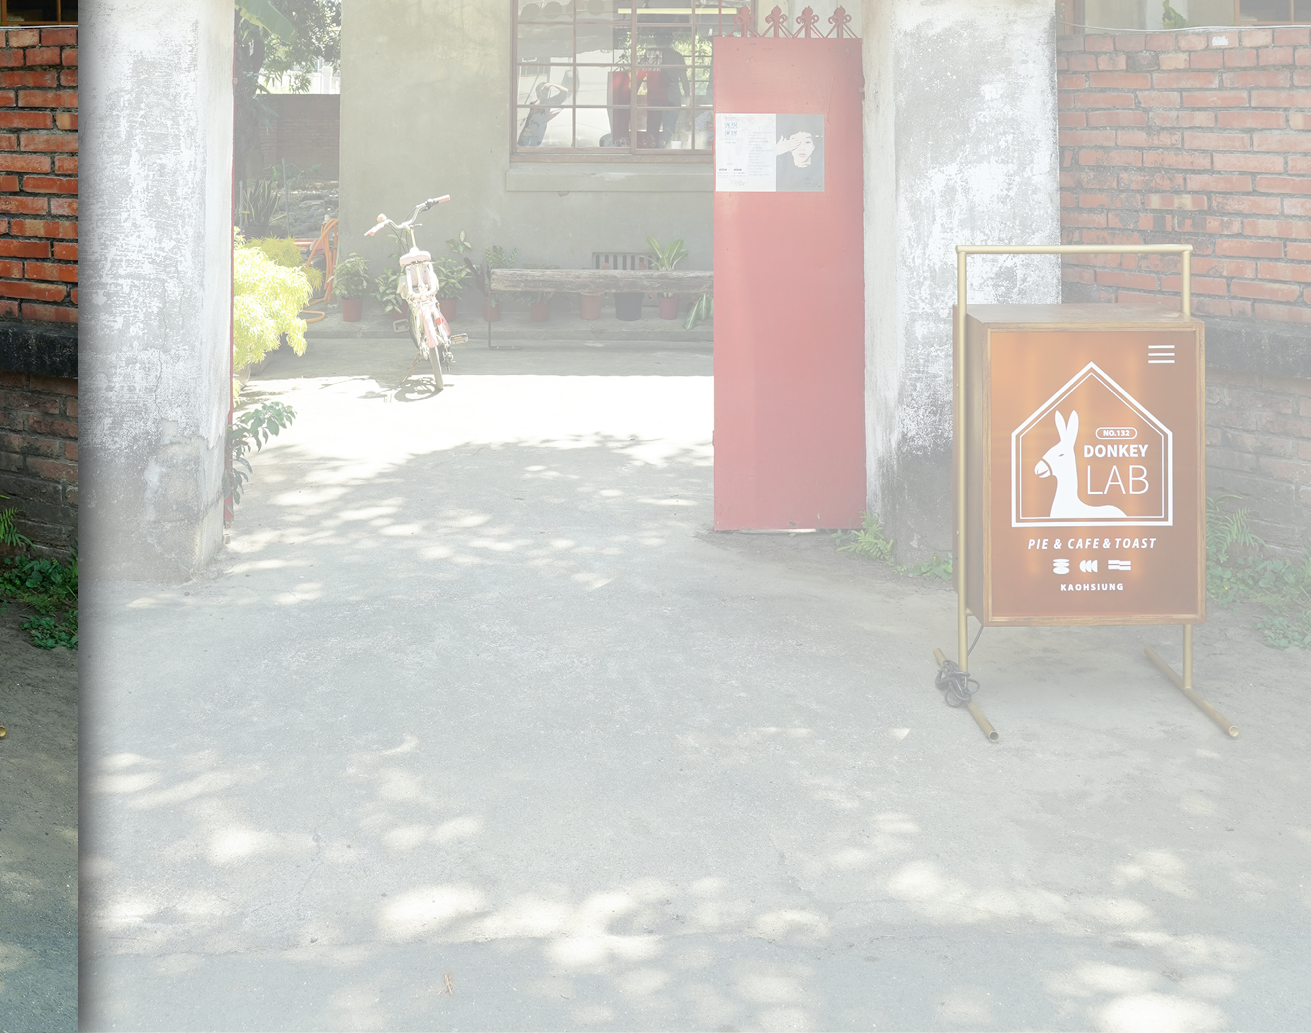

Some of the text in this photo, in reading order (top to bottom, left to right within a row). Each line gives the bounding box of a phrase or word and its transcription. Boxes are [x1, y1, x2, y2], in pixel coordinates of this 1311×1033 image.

[1102, 429, 1130, 437] NO.132
[1083, 444, 1149, 458] DONKEY
[1087, 464, 1149, 495] LAB
[1027, 538, 1157, 550] PIE & CAFE & TOAST
[1060, 583, 1124, 592] KAOHSIUNG
